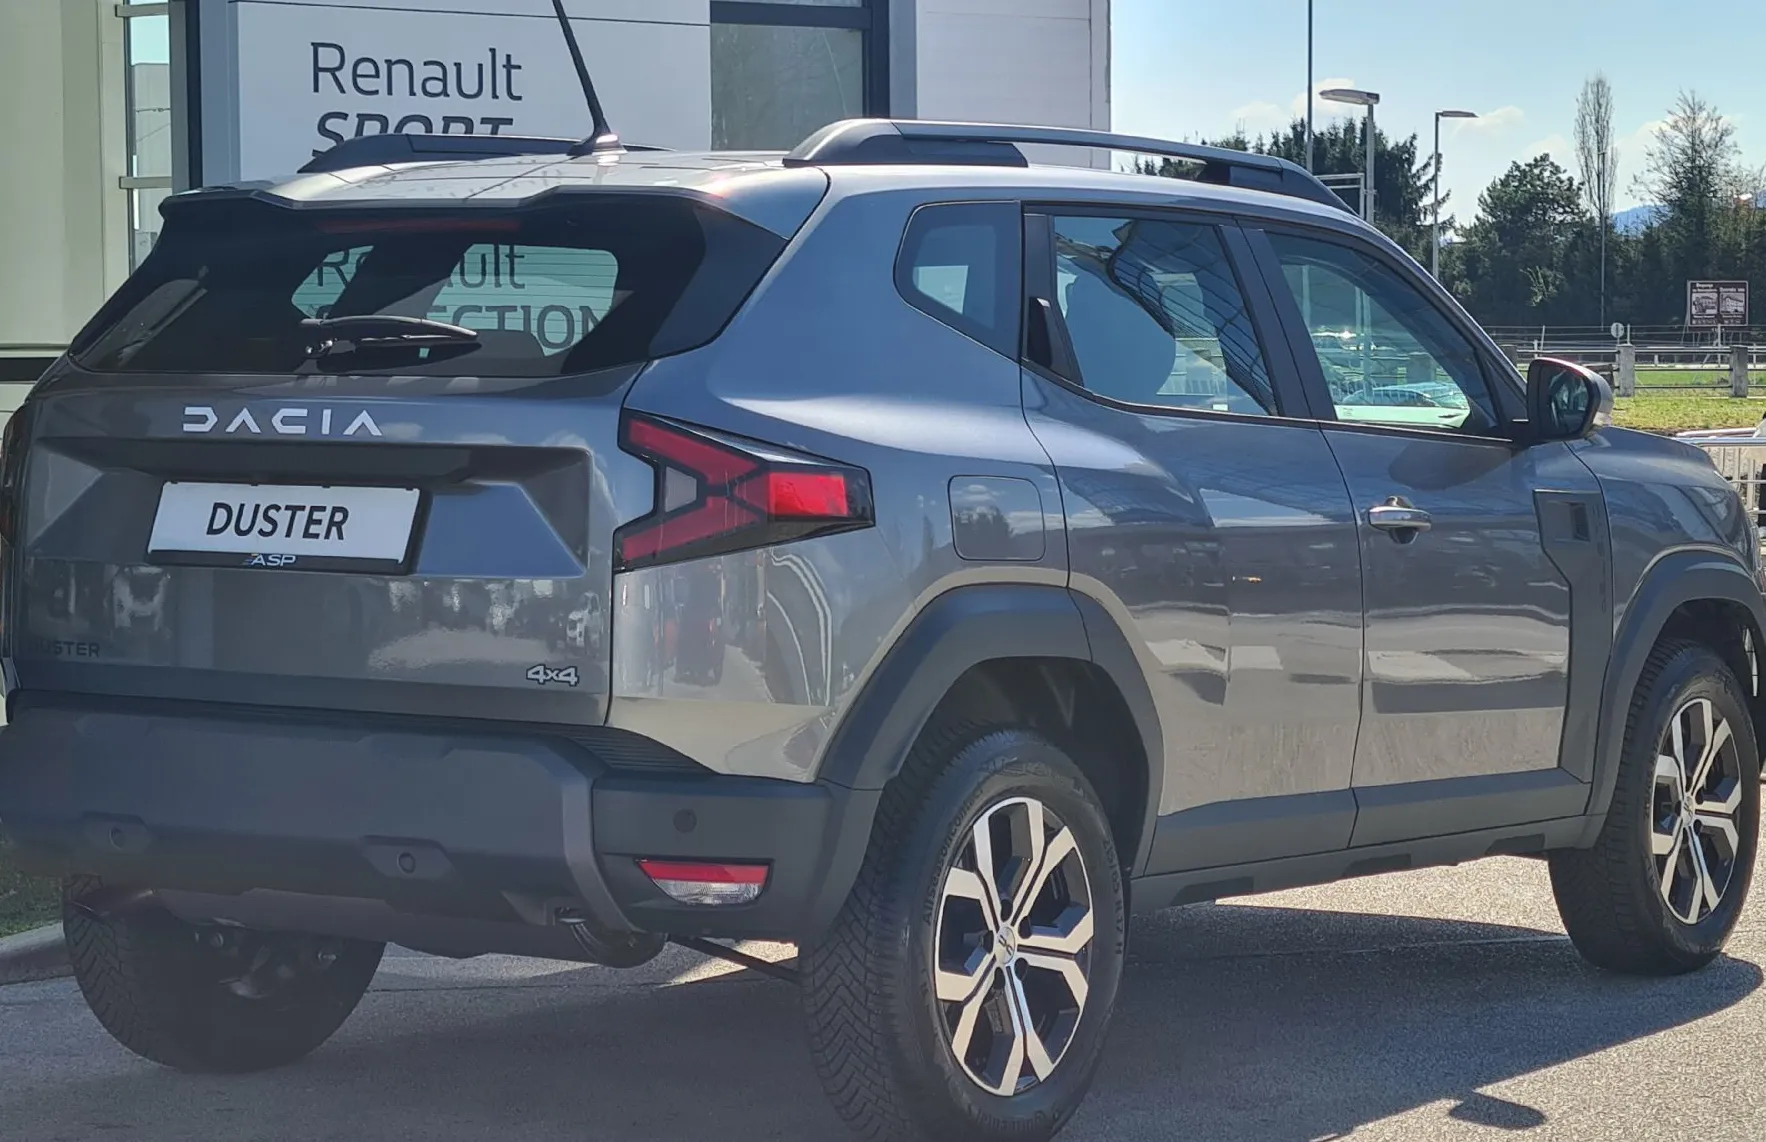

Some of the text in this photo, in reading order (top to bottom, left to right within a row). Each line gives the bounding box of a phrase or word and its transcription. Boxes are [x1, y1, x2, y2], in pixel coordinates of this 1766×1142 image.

[310, 41, 523, 101] Renault
[182, 406, 383, 436] DACIA
[206, 502, 349, 541] DUSTER
[250, 553, 297, 567] ASP
[526, 663, 580, 687] 4x4
